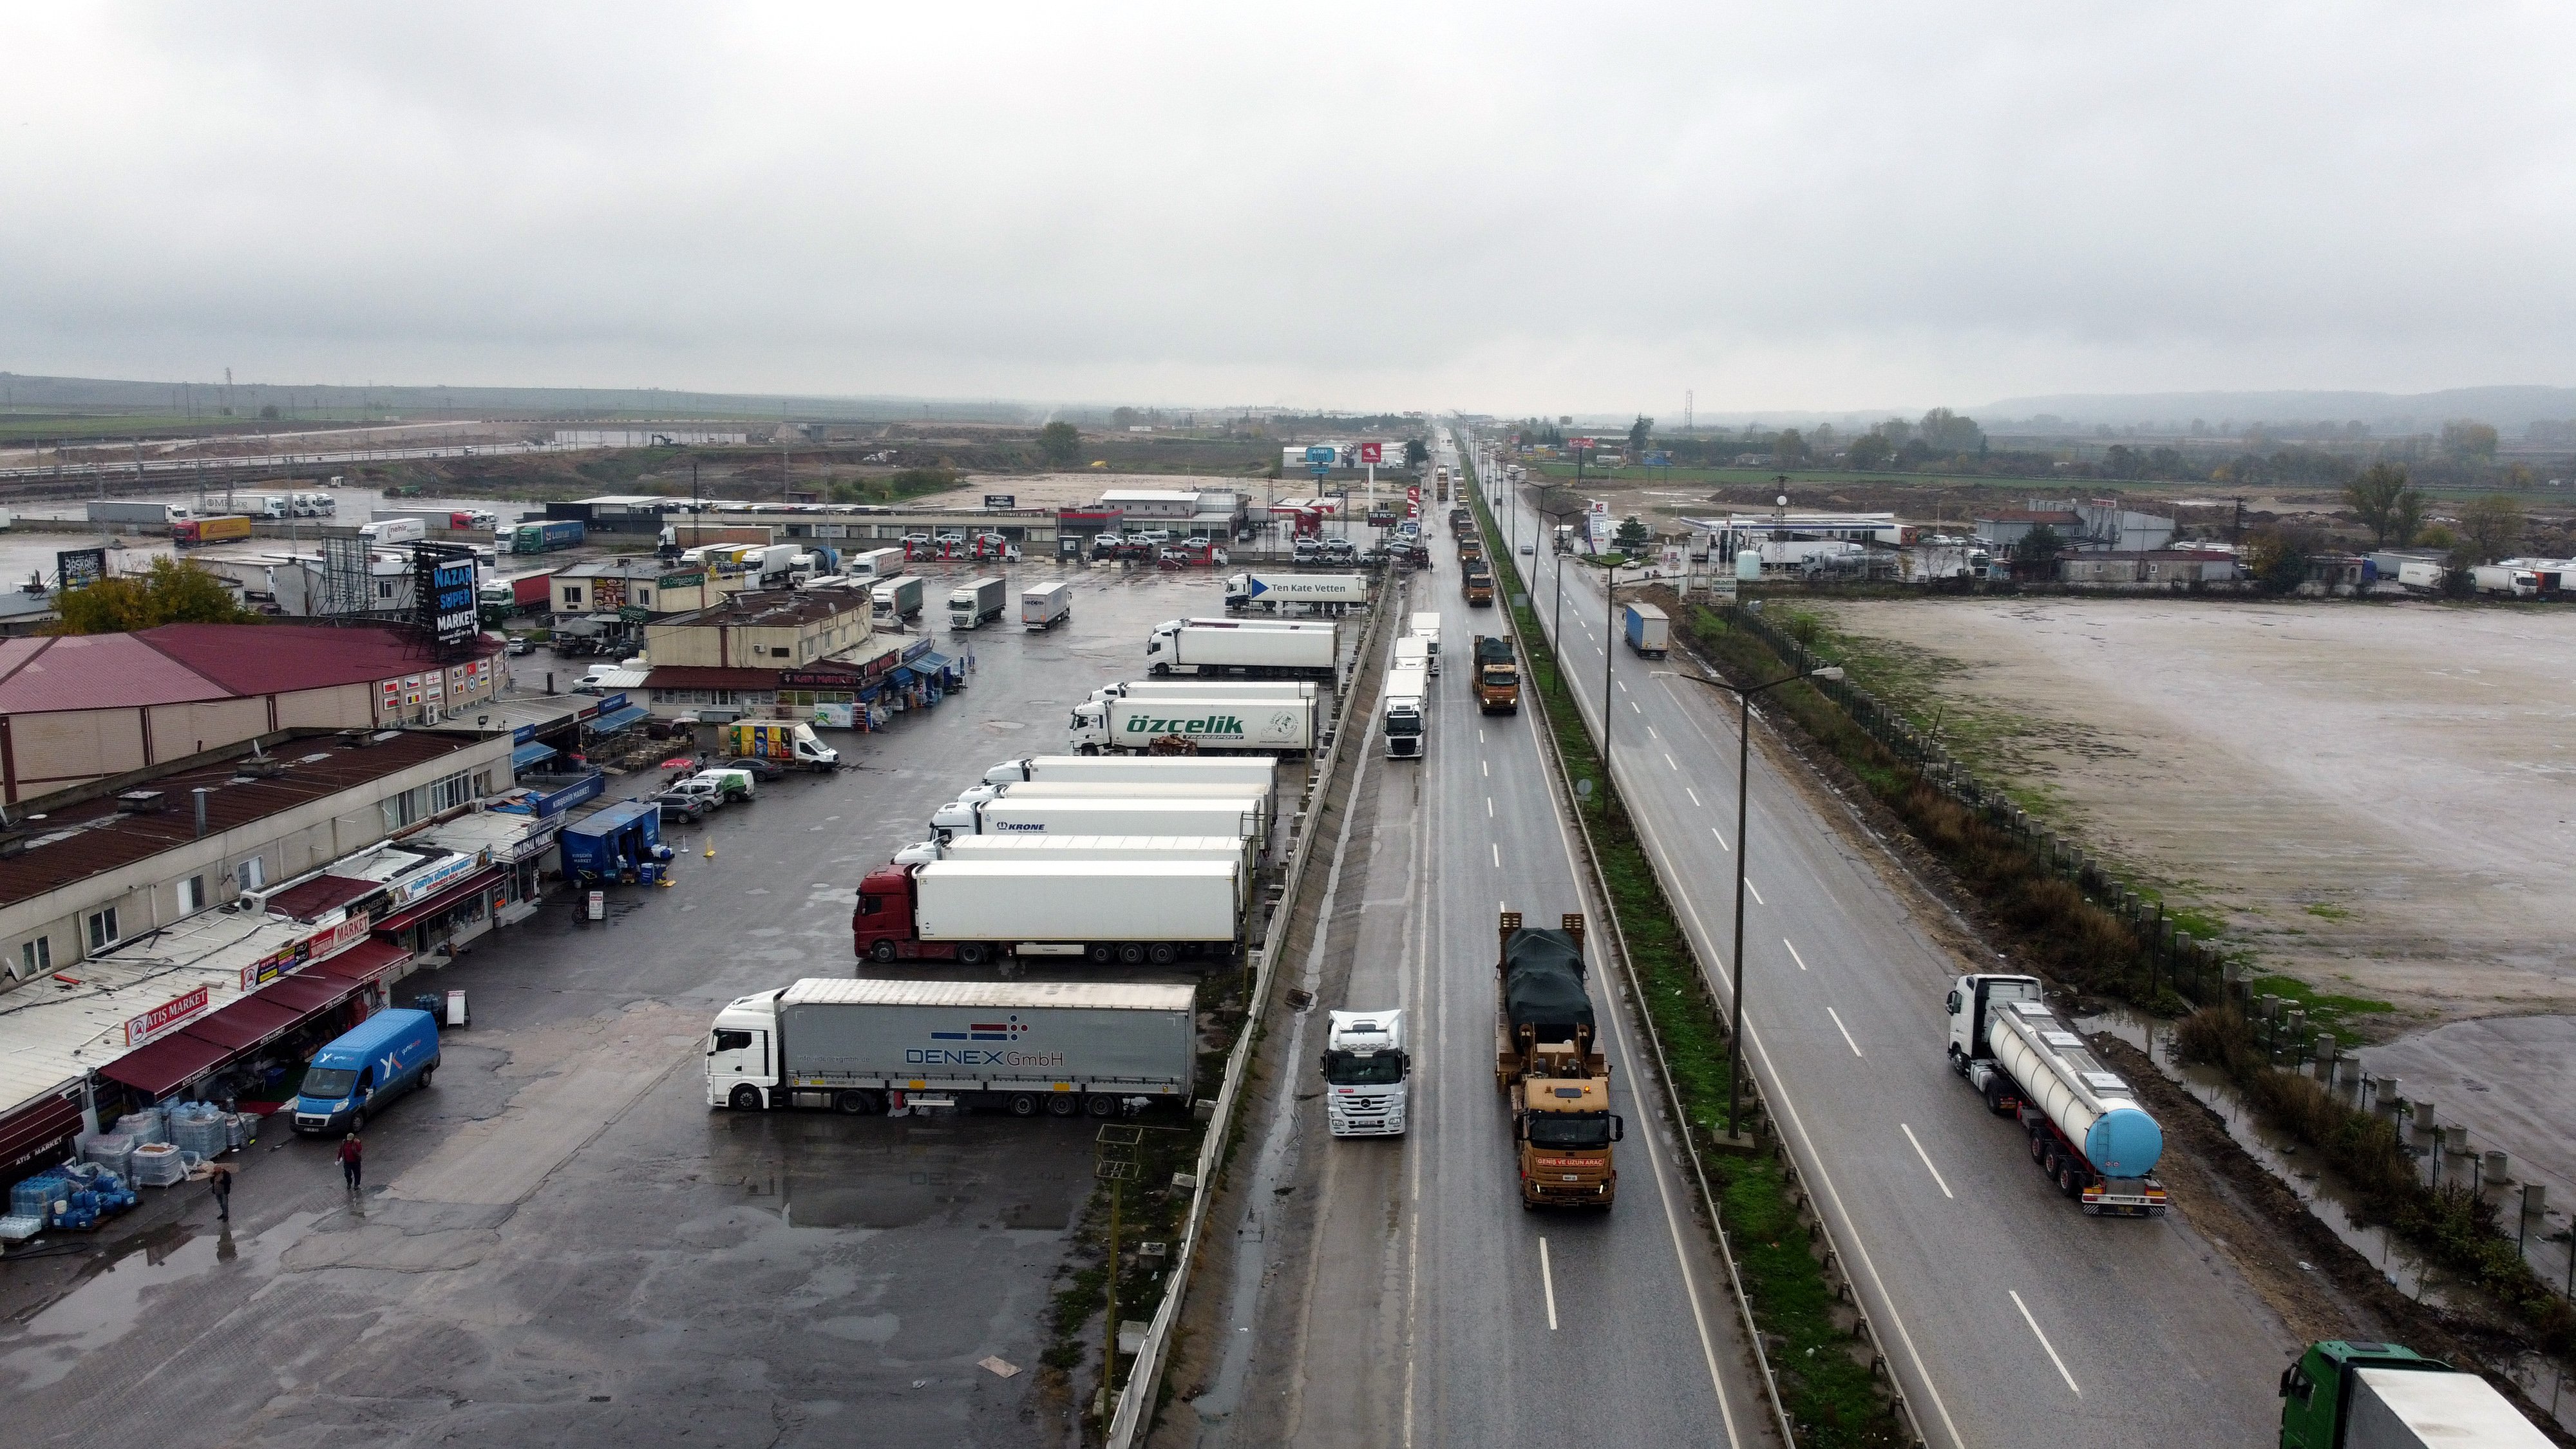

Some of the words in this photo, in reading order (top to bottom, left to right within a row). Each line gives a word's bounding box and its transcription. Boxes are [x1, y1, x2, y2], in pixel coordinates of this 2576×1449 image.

[390, 524, 407, 533] nehir
[434, 566, 471, 588] NAZAR
[437, 610, 474, 632] MARKET
[573, 786, 590, 799] MARKET
[535, 829, 553, 848] MARKET
[337, 916, 368, 943] MARKET
[146, 1008, 167, 1029] ATIŞ
[168, 990, 206, 1019] MARKET
[905, 1048, 1004, 1065] DENEX
[1007, 1050, 1063, 1066] GmbH
[192, 1066, 211, 1081] MARKET
[35, 1136, 62, 1156] MARKET
